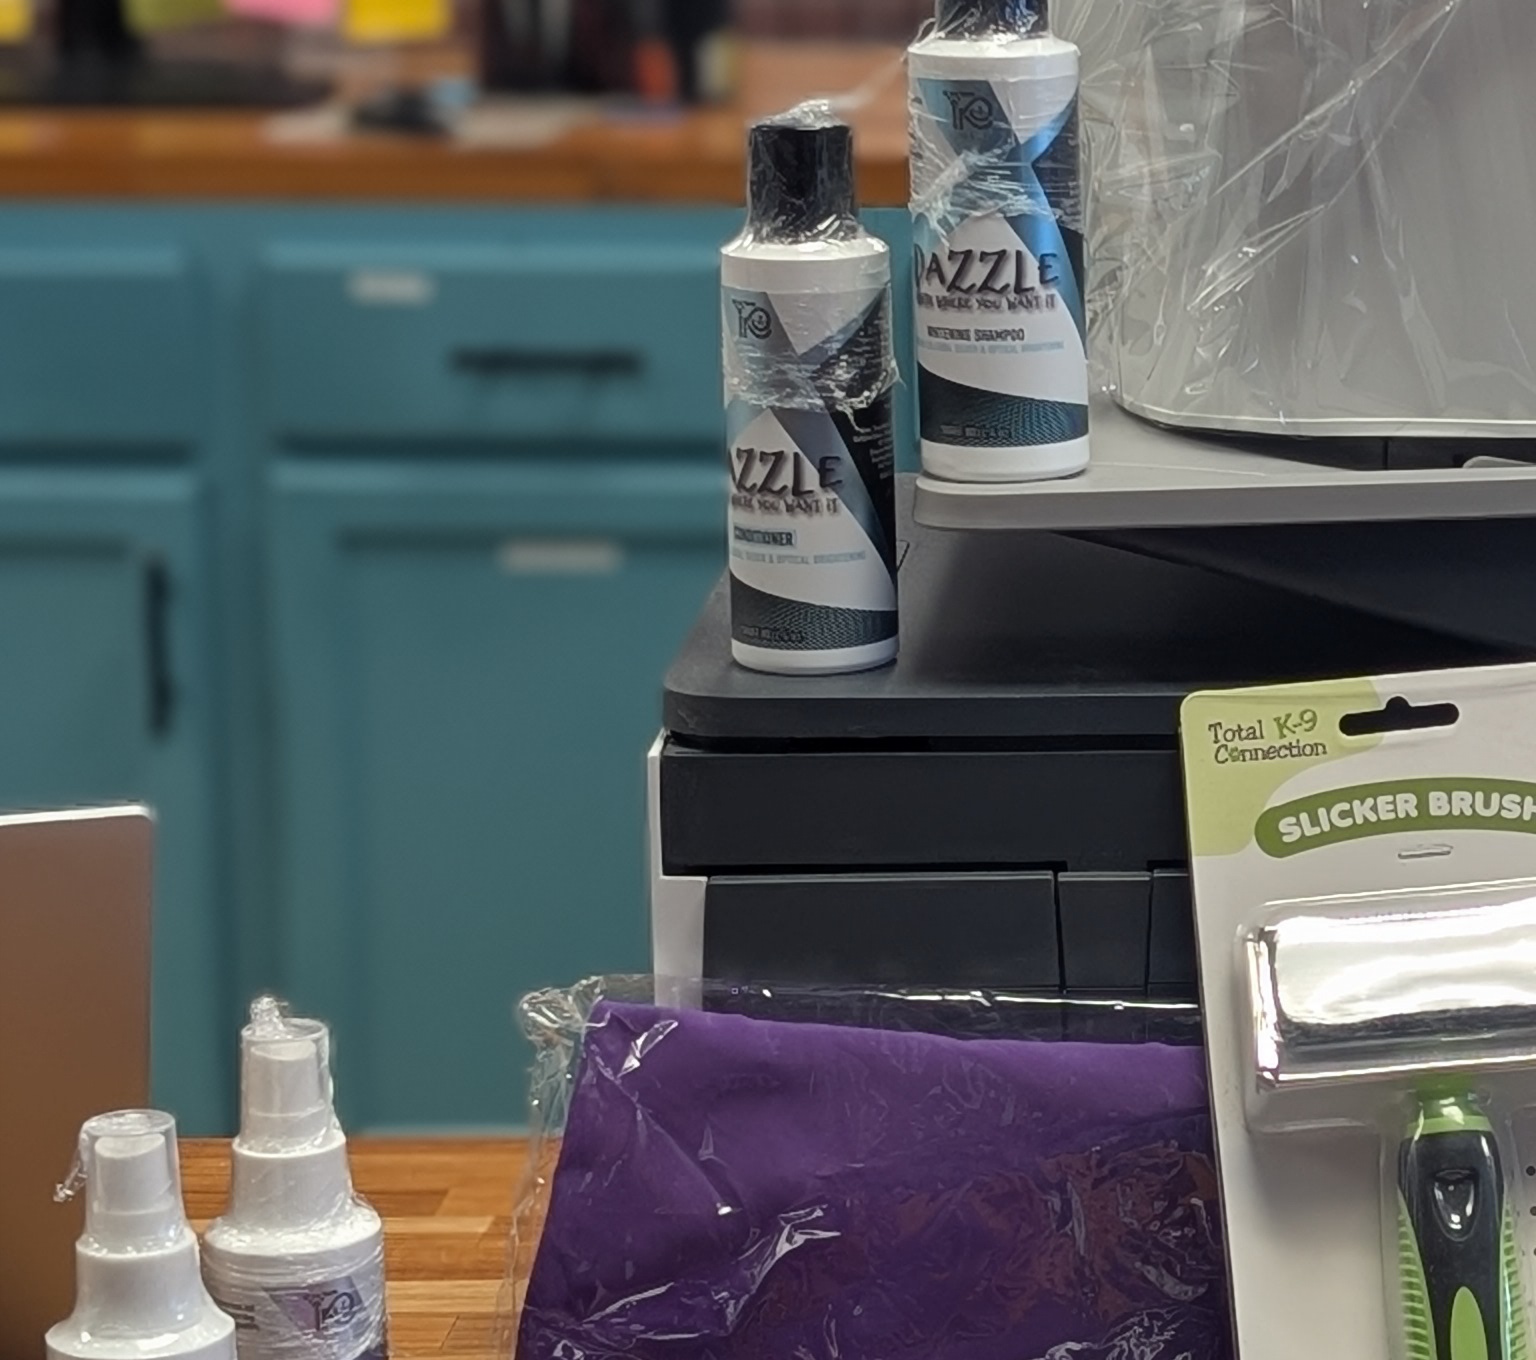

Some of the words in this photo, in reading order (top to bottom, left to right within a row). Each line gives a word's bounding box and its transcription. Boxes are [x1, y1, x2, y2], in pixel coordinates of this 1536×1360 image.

[1209, 721, 1264, 744] Total
[1273, 708, 1318, 739] K-9
[1278, 793, 1418, 843] SLICKER
